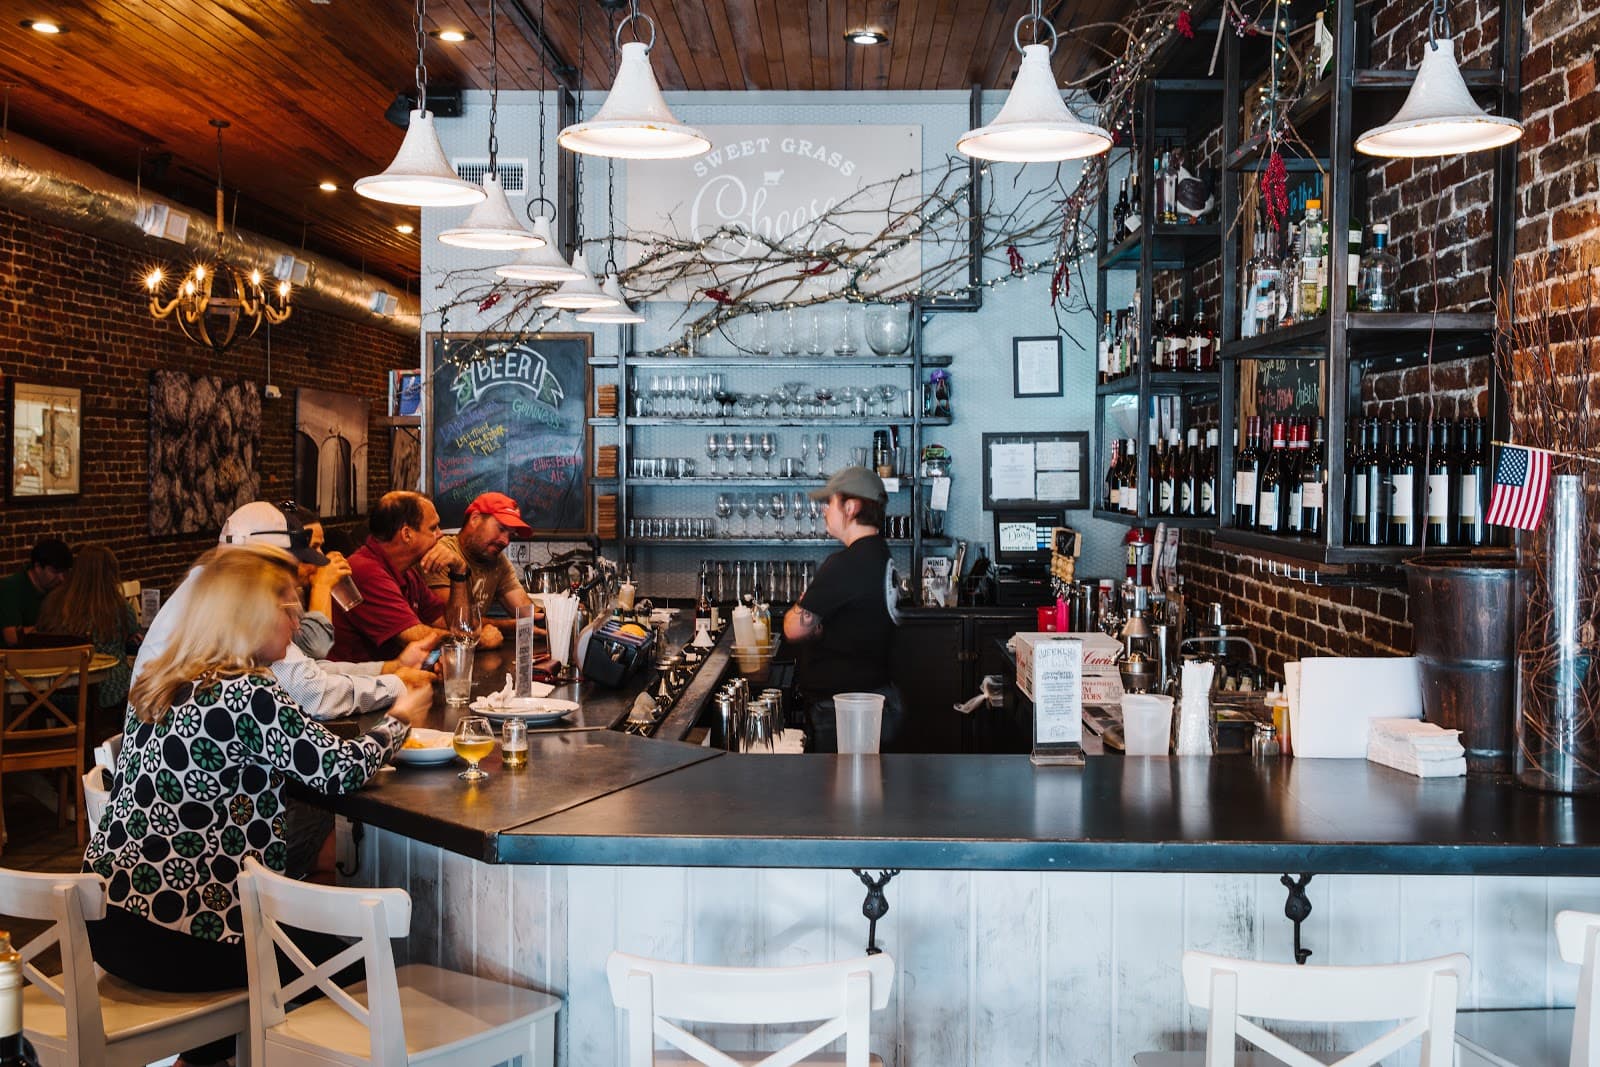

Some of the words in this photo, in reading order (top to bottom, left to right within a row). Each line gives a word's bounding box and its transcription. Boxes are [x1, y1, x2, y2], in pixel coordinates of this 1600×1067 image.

[693, 137, 770, 177] SWEET
[781, 137, 856, 177] GRASS
[476, 352, 541, 385] BEER!
